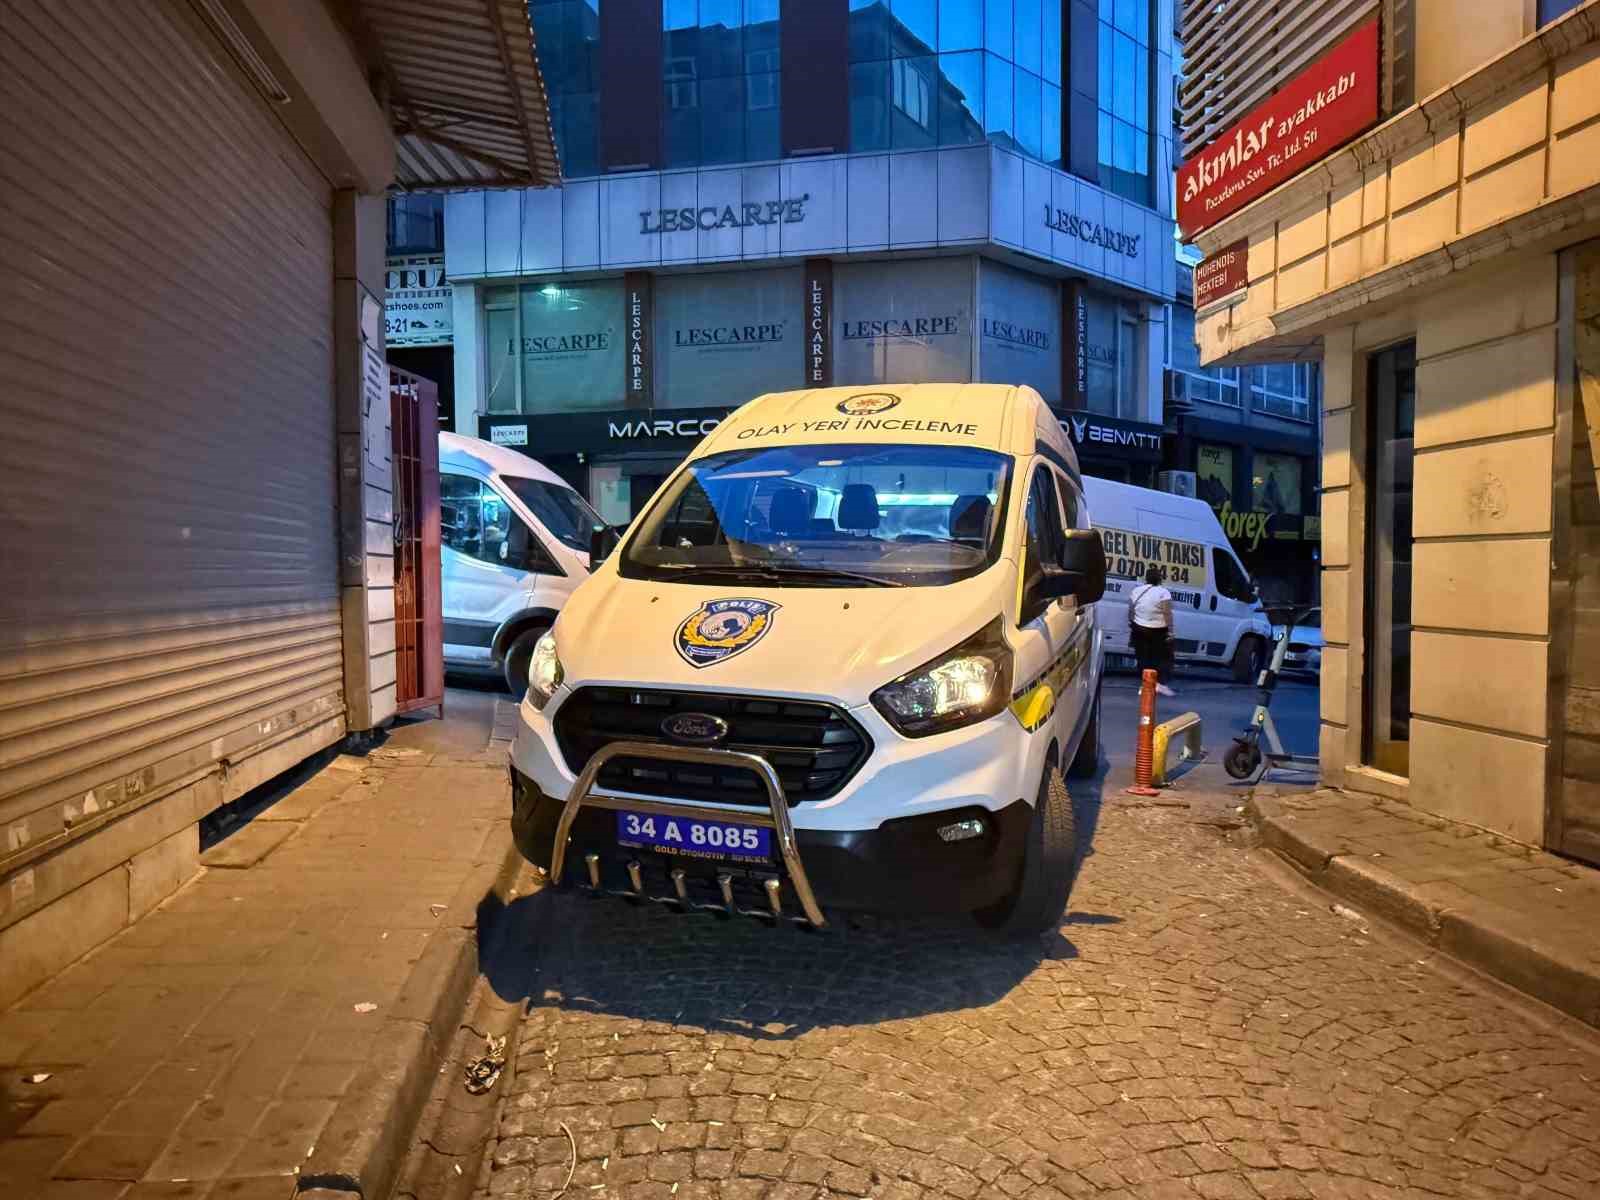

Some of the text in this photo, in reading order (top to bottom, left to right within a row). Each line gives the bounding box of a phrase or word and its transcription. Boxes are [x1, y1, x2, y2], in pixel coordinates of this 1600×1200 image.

[1277, 72, 1356, 138] ayakkabı
[639, 197, 807, 234] LESCARPE
[1043, 205, 1138, 258] LESCARPE
[632, 292, 642, 390] LESCARPE
[675, 324, 783, 345] LESCARPE
[811, 280, 823, 381] LESCARPE
[842, 316, 958, 338] LESCARPE
[983, 318, 1049, 350] LESCARPE
[508, 332, 609, 355] LESCARPE
[1077, 296, 1086, 392] LESCARPE
[609, 419, 720, 437] MARCO
[736, 417, 979, 440] OLAY YERİ İNCELEME
[1088, 425, 1160, 449] BENATTI
[1117, 558, 1145, 577] 070
[1171, 566, 1189, 583] 34
[626, 814, 759, 849] 34 A 8085
